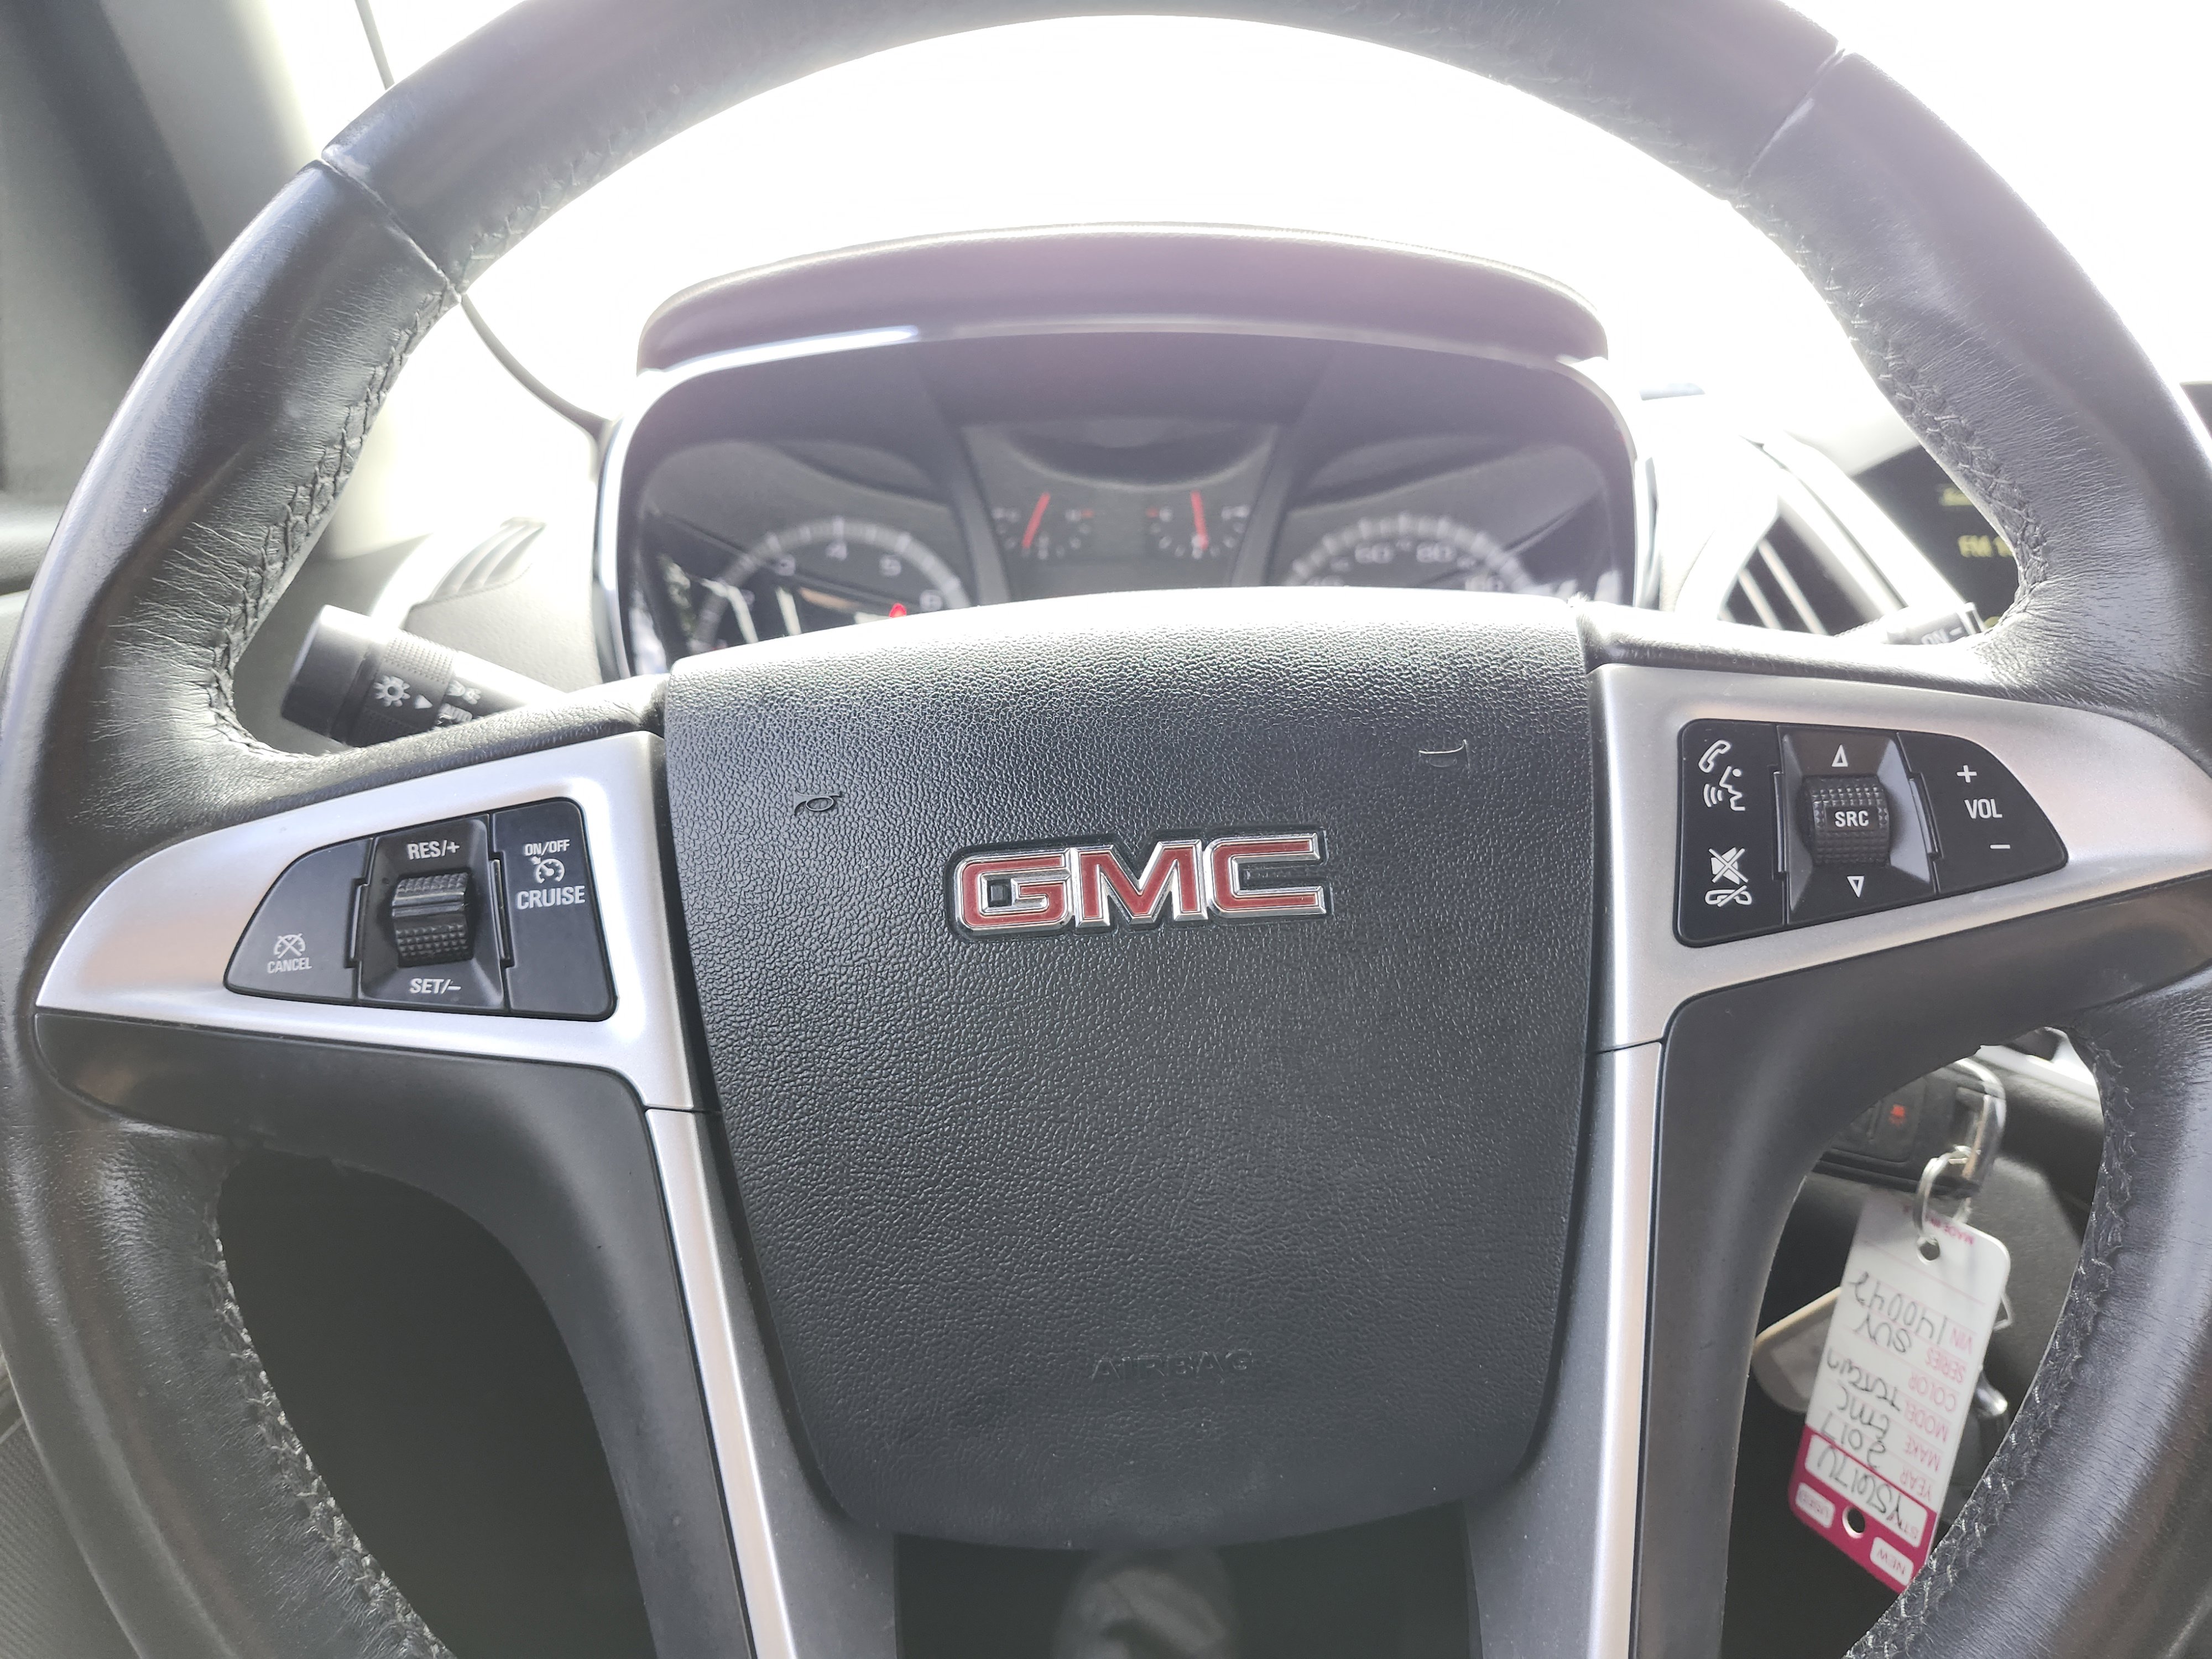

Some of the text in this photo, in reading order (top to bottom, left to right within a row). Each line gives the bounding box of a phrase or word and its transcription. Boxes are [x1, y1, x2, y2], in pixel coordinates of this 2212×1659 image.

[1834, 811, 1869, 827] SRC
[1965, 799, 2002, 819] VOL
[407, 840, 460, 860] RES/+
[524, 839, 570, 857] ON/OFF
[517, 885, 586, 910] CRUISE
[956, 833, 1327, 931] GMC
[267, 957, 313, 973] CANCEL
[1853, 1313, 1912, 1353] SUV
[1950, 1328, 1973, 1354] VIN
[1926, 1347, 1966, 1384] SERIES
[1908, 1370, 1958, 1412] COLOR
[1904, 1400, 1949, 1443] MODEL
[1821, 1411, 1886, 1469] 2017
[1903, 1436, 1941, 1472] MAKE
[1900, 1465, 1932, 1501] YEAR
[1876, 1548, 1907, 1575] NEW
